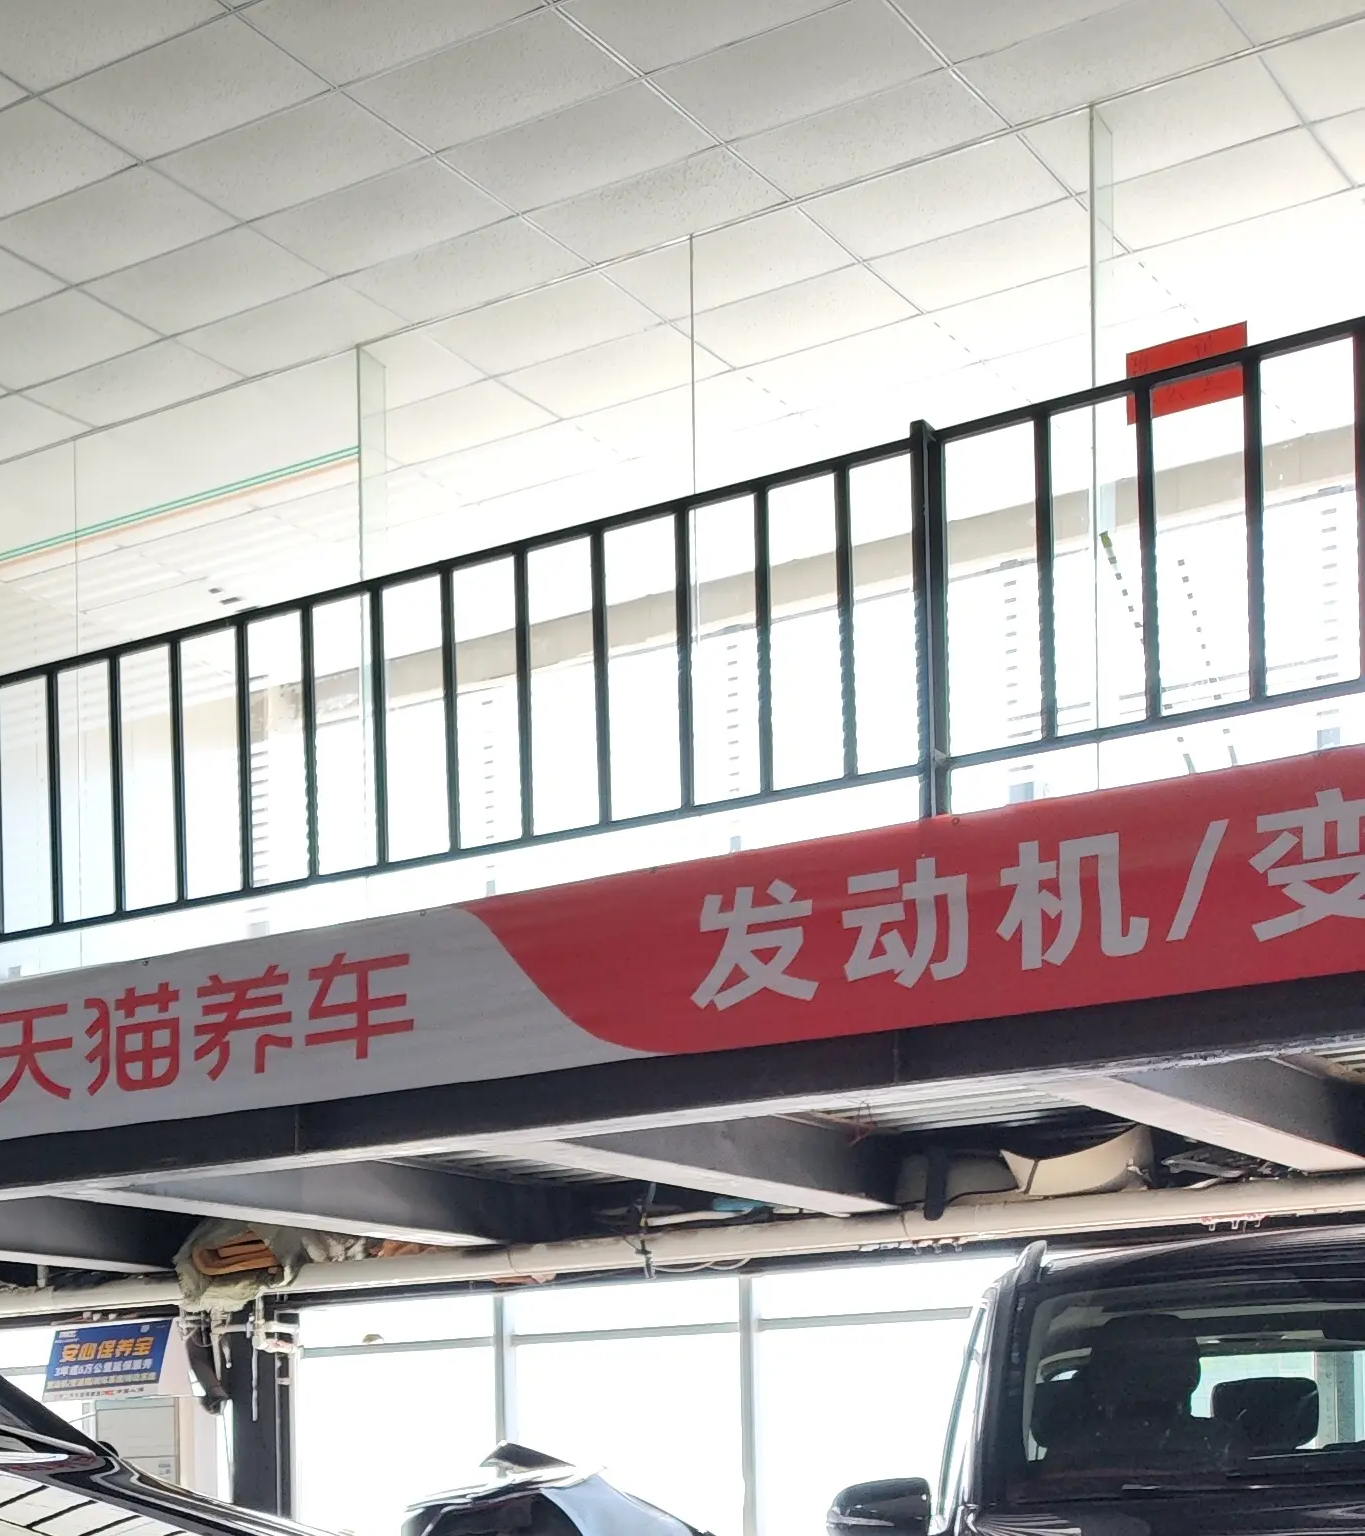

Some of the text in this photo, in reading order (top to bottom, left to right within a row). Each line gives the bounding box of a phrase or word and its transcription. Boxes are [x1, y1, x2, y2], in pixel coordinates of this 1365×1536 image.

[59, 1337, 154, 1362] 安心保养宝
